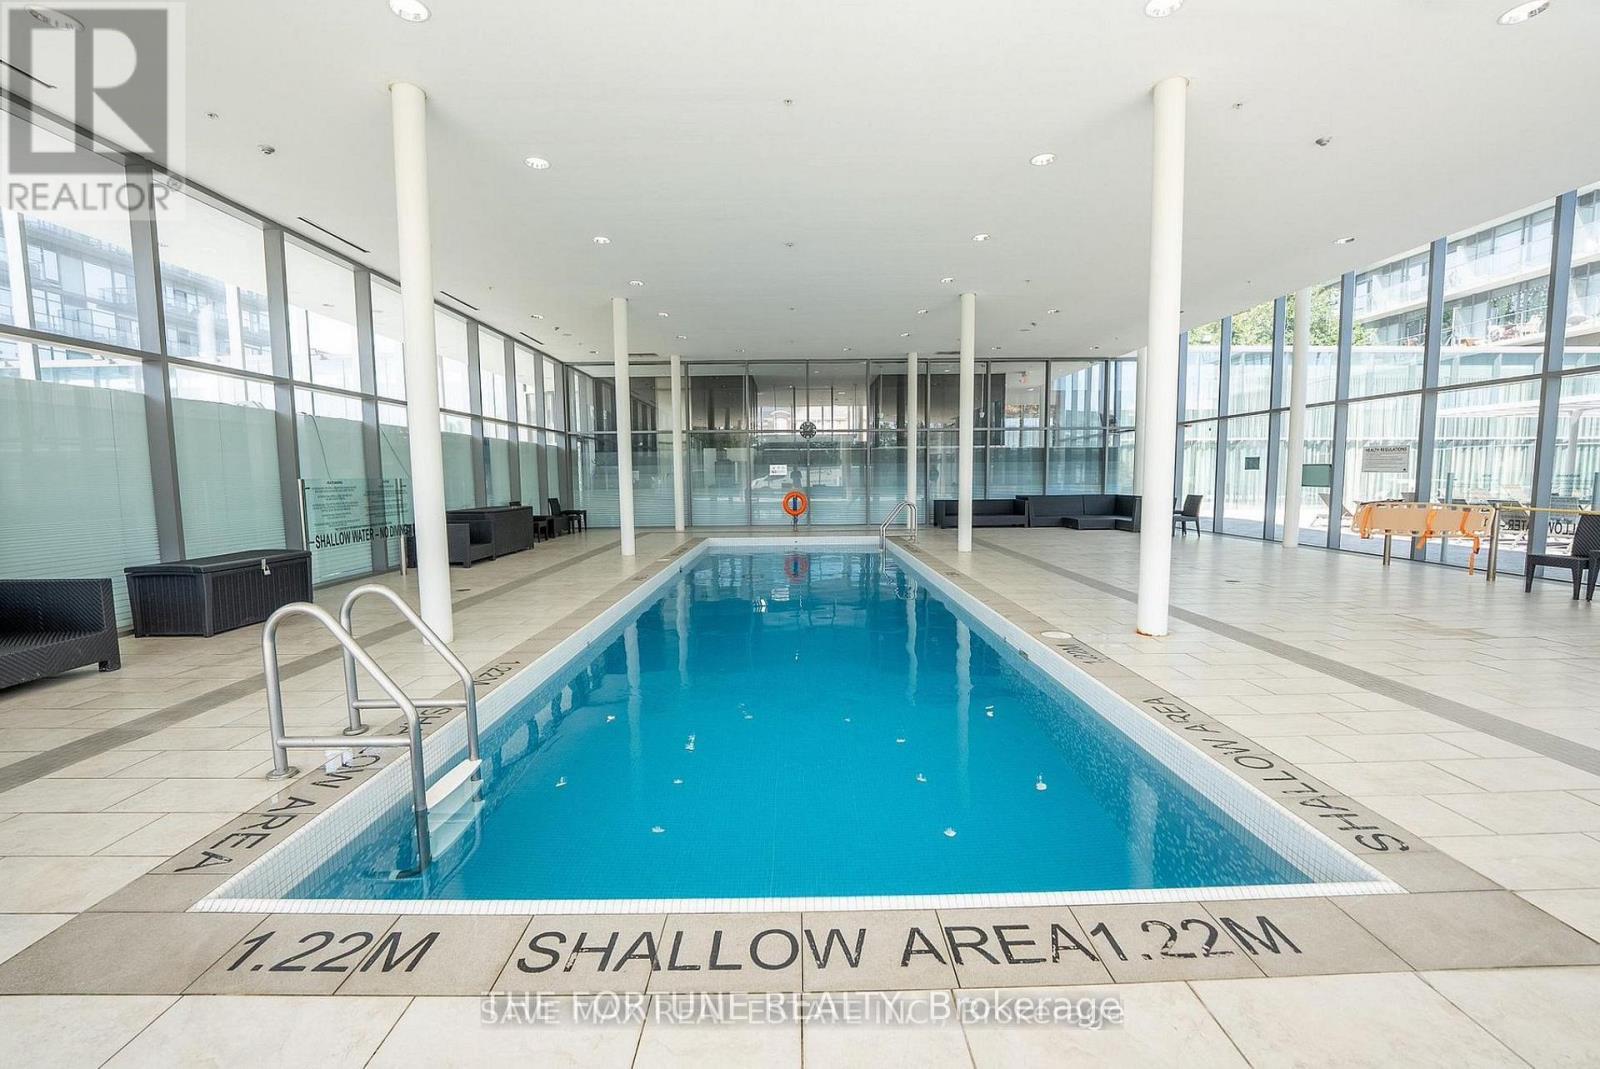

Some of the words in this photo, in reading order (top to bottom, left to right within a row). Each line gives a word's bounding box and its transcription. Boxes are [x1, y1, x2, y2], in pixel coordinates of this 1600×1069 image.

[315, 530, 351, 549] SHALLOW
[352, 527, 374, 544] WATER
[380, 525, 389, 539] NO
[1141, 696, 1221, 733] AREA
[1202, 737, 1411, 853] SHALLOW
[174, 796, 317, 873] AREA
[227, 931, 440, 974] 1.22M
[517, 928, 867, 973] SHALLOW
[900, 922, 1100, 968] AREA
[1090, 915, 1303, 962] 1.22M
